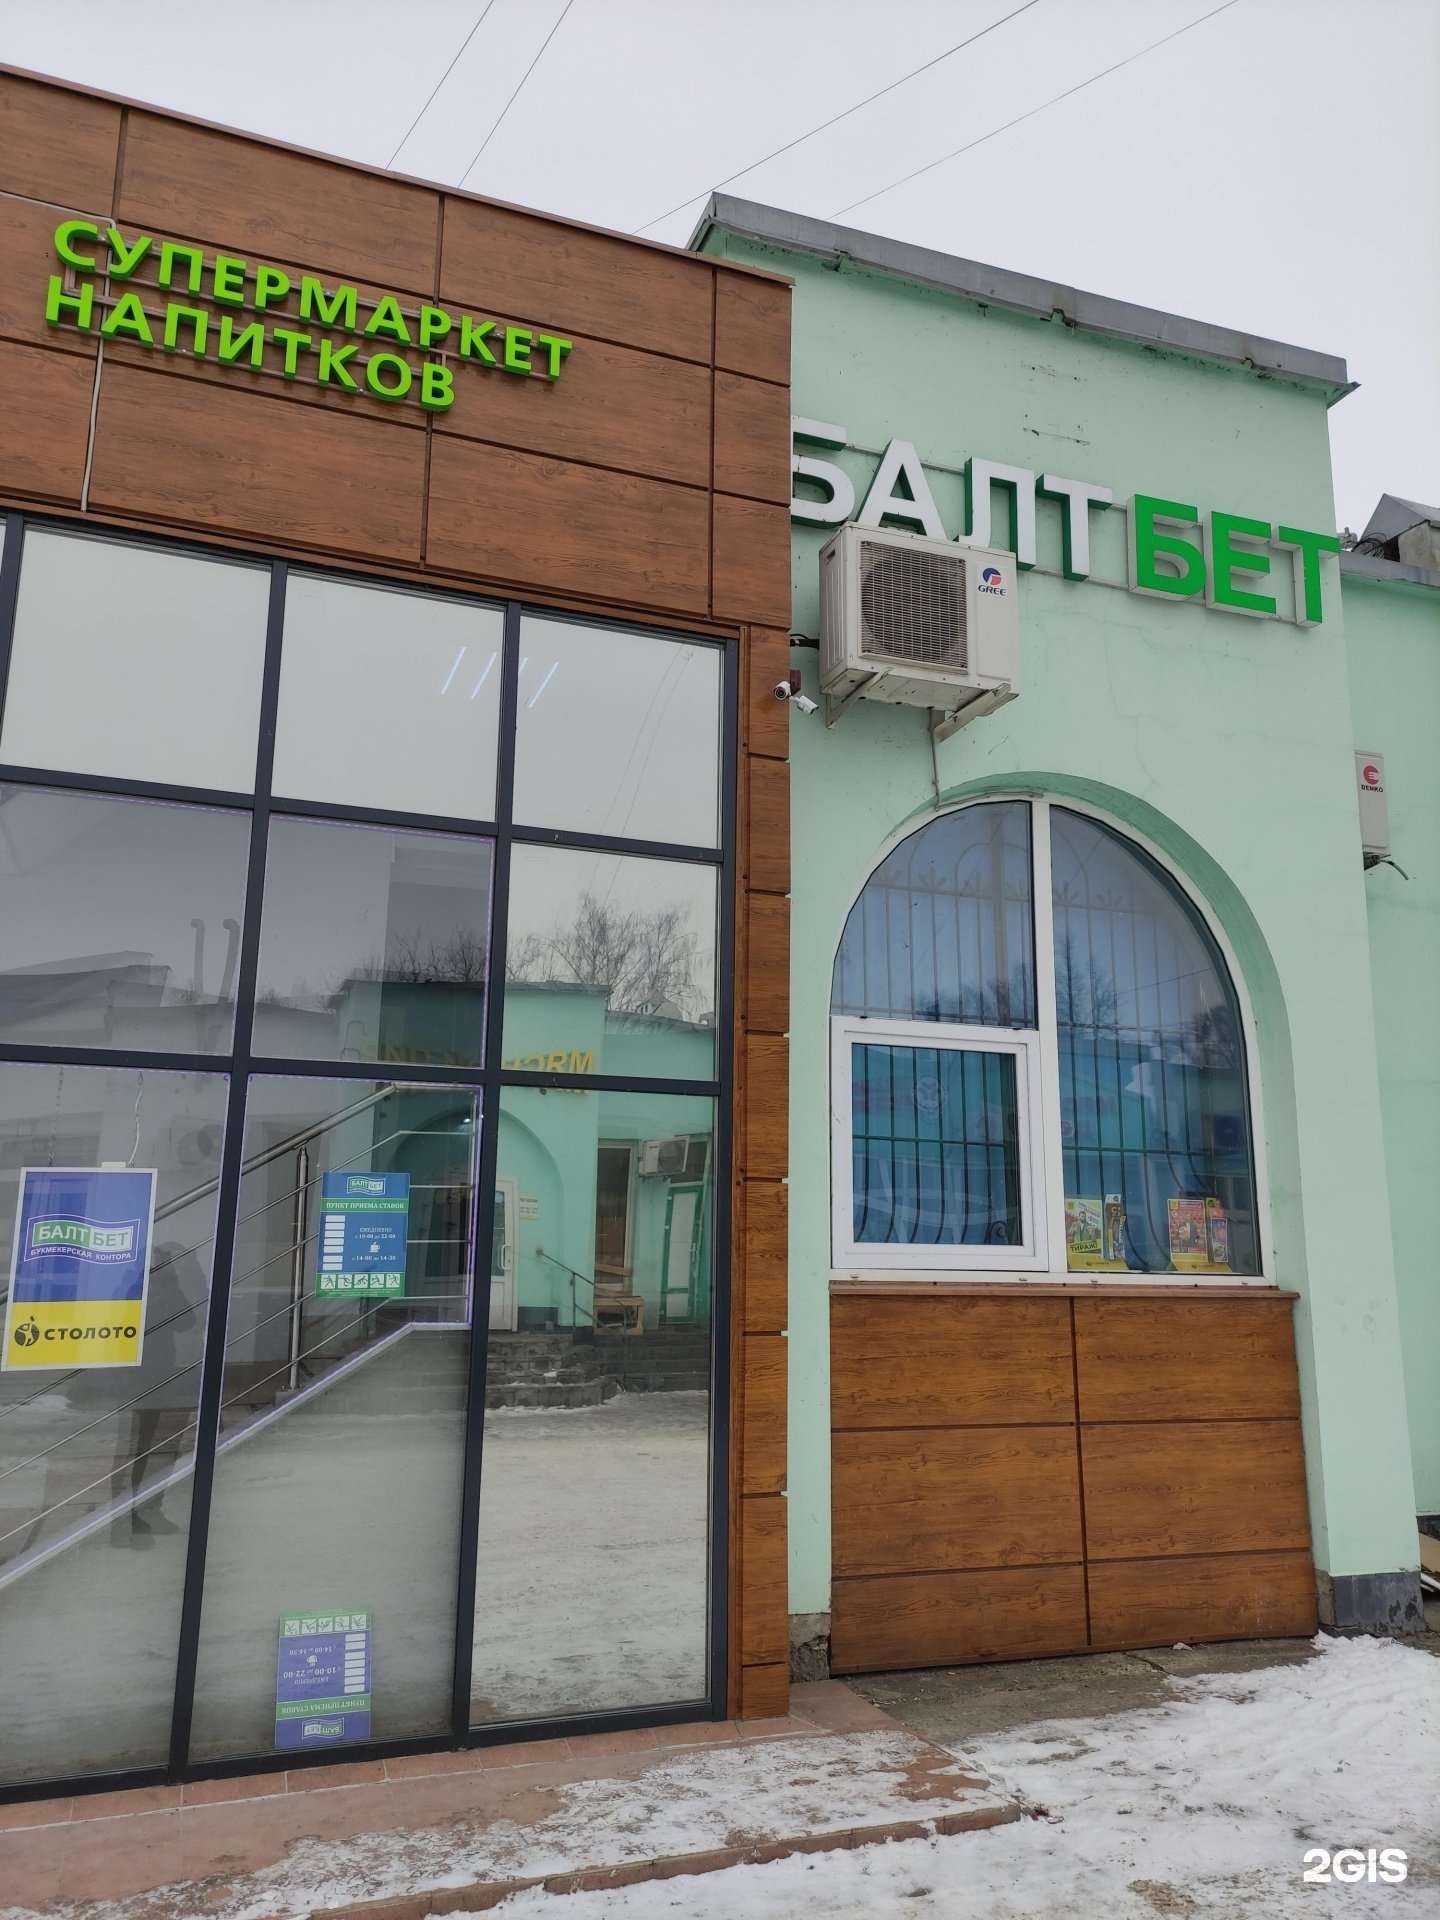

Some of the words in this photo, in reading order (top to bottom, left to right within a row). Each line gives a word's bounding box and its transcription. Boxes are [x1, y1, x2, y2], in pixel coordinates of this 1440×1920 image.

[53, 220, 573, 382] СУПЕРМАРКЕТ
[45, 275, 456, 412] НАПИТКОВ
[978, 585, 1007, 596] GREE
[38, 1225, 129, 1248] БАЛТБЕТ
[30, 1246, 92, 1258] БУКМЕКЕРСКАЯ
[95, 1252, 131, 1261] КОНТОРА
[44, 1326, 137, 1341] СТОЛОТО
